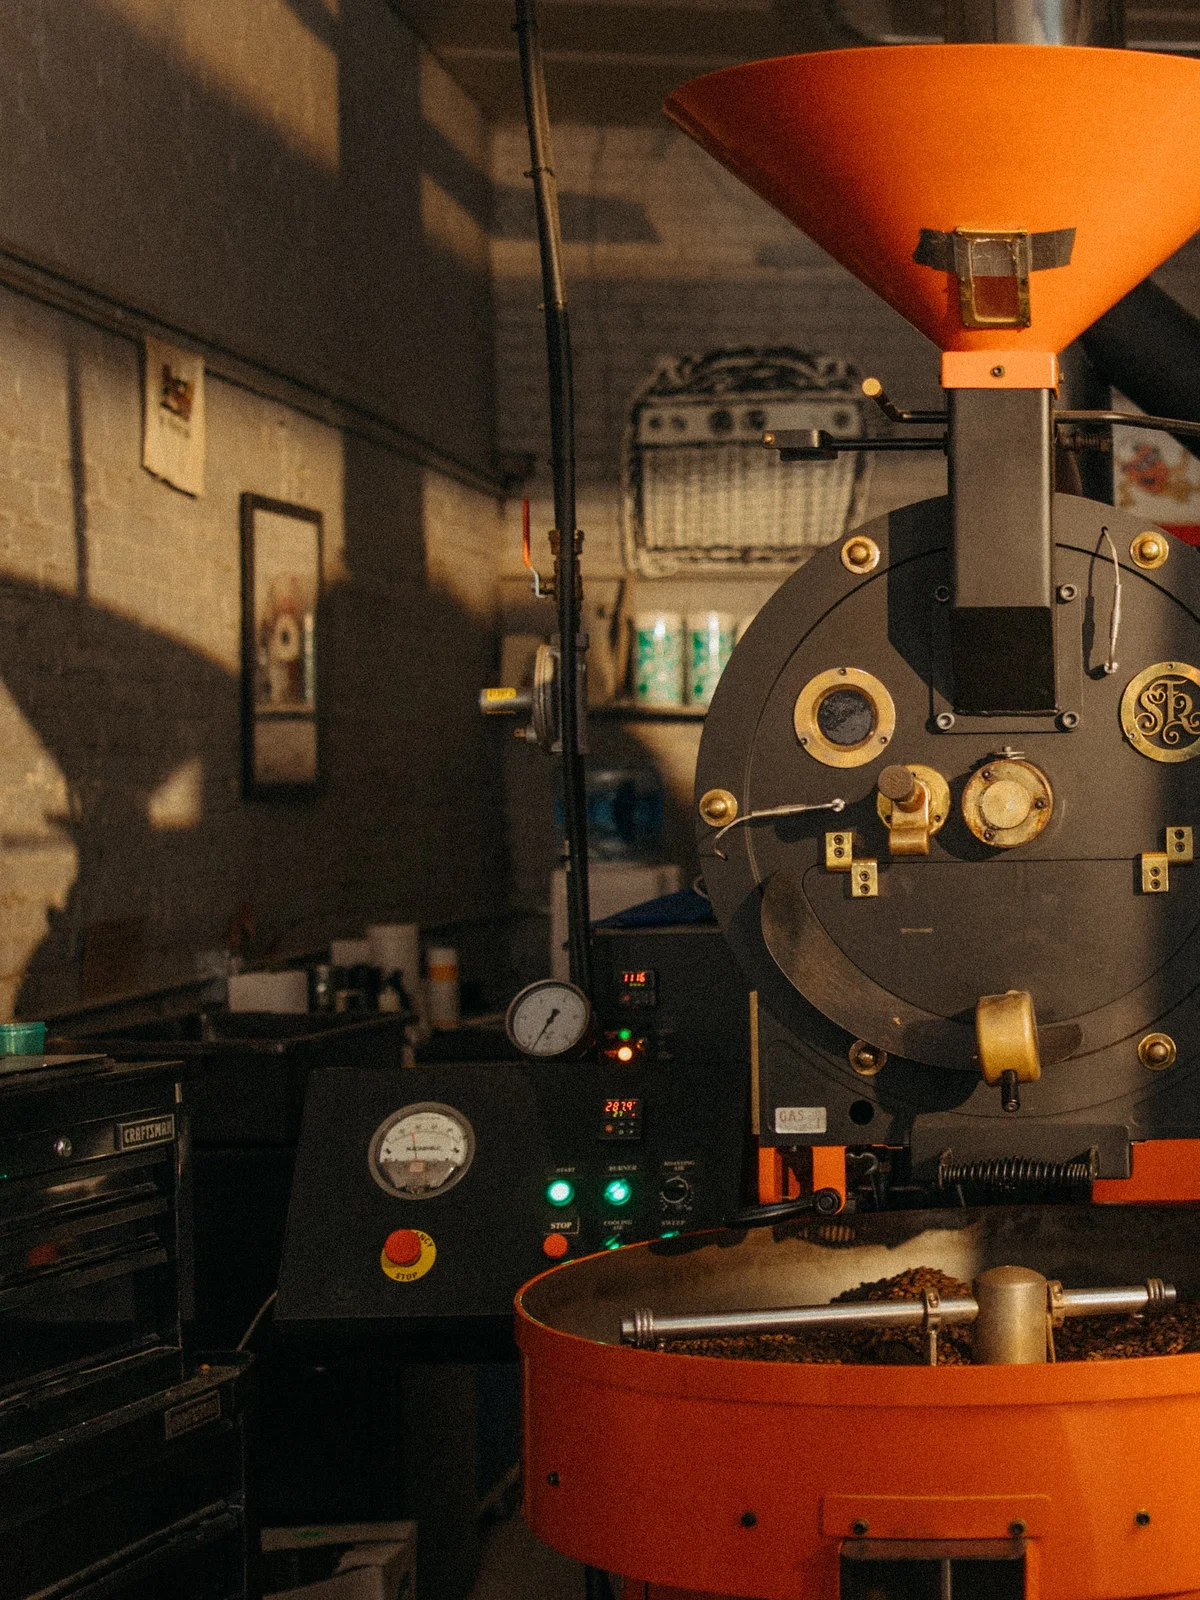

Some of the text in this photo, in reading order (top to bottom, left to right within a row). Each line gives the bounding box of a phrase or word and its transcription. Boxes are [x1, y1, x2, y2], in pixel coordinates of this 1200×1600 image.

[779, 1110, 804, 1123] GAS
[124, 1119, 172, 1144] CRAFTSMAN
[550, 1221, 573, 1230] STOP
[395, 1271, 418, 1280] STOP
